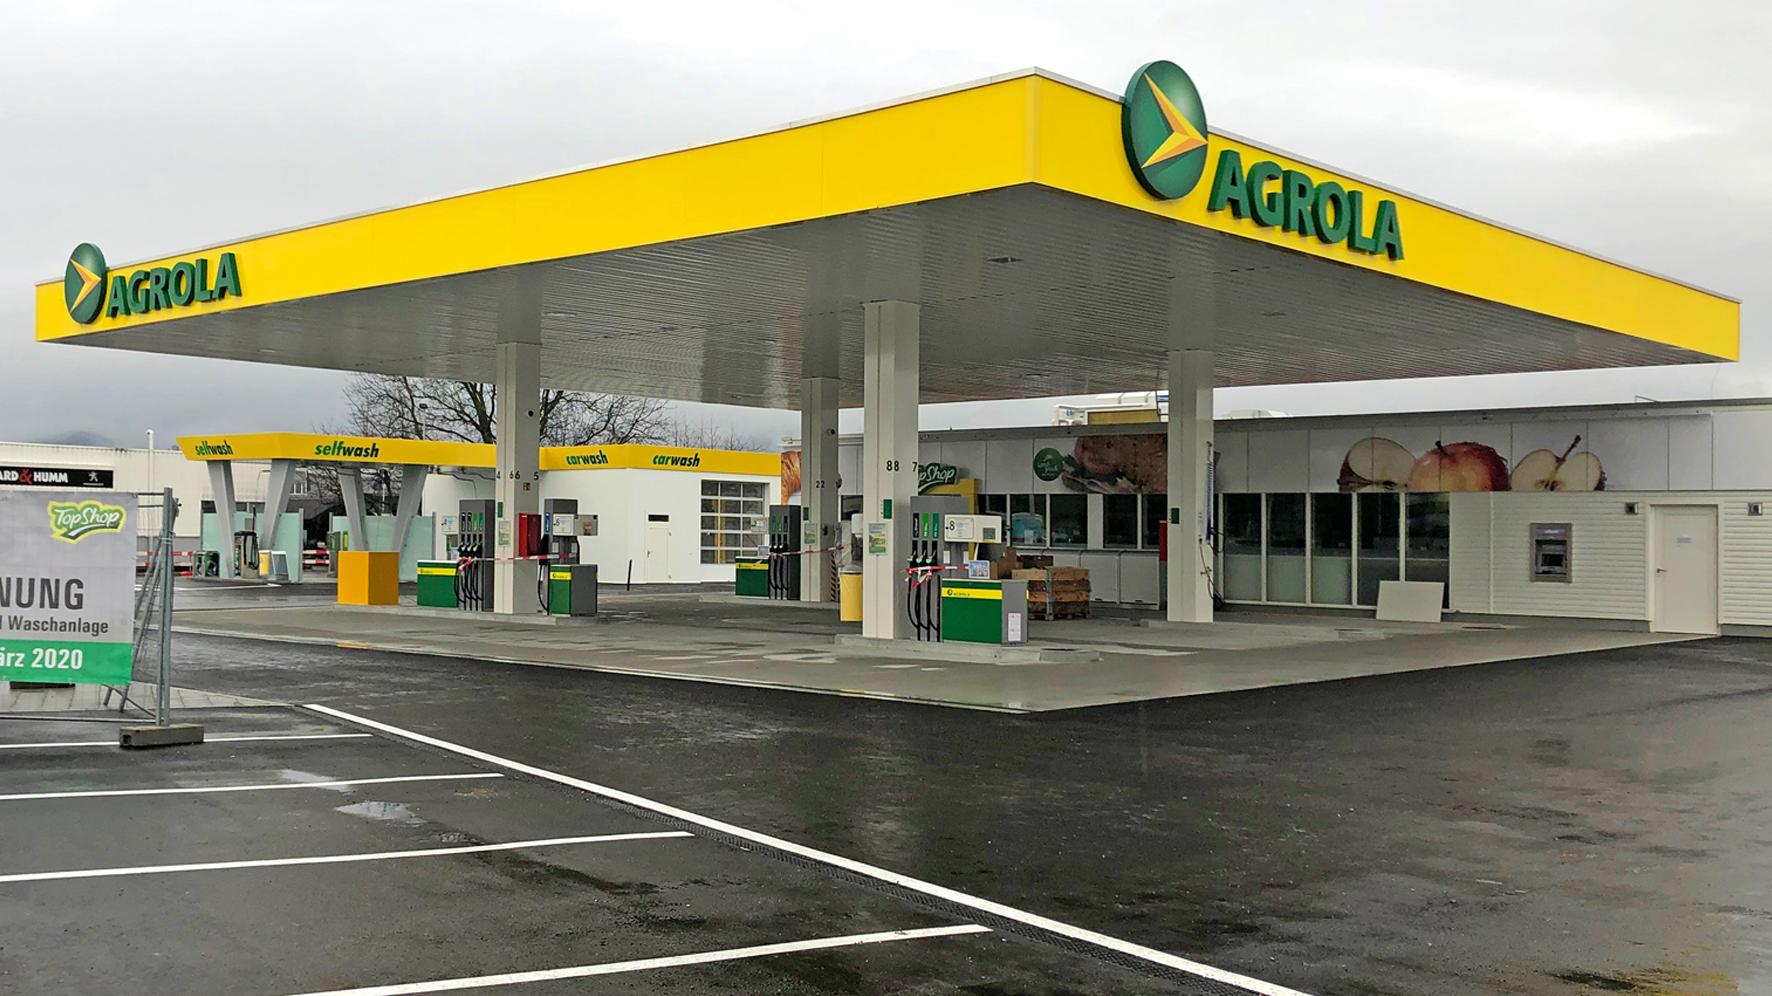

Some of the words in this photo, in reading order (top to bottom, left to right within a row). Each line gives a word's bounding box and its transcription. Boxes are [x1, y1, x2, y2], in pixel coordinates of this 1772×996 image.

[1207, 149, 1405, 261] AGROLA
[106, 252, 242, 318] AGROLA
[195, 440, 234, 456] selfwash
[314, 440, 380, 458] selfwash
[566, 450, 609, 465] carwash
[652, 453, 701, 467] carwash
[33, 470, 69, 483] HUMM
[8, 615, 109, 637] Waschanlage
[31, 648, 83, 670] 2020
